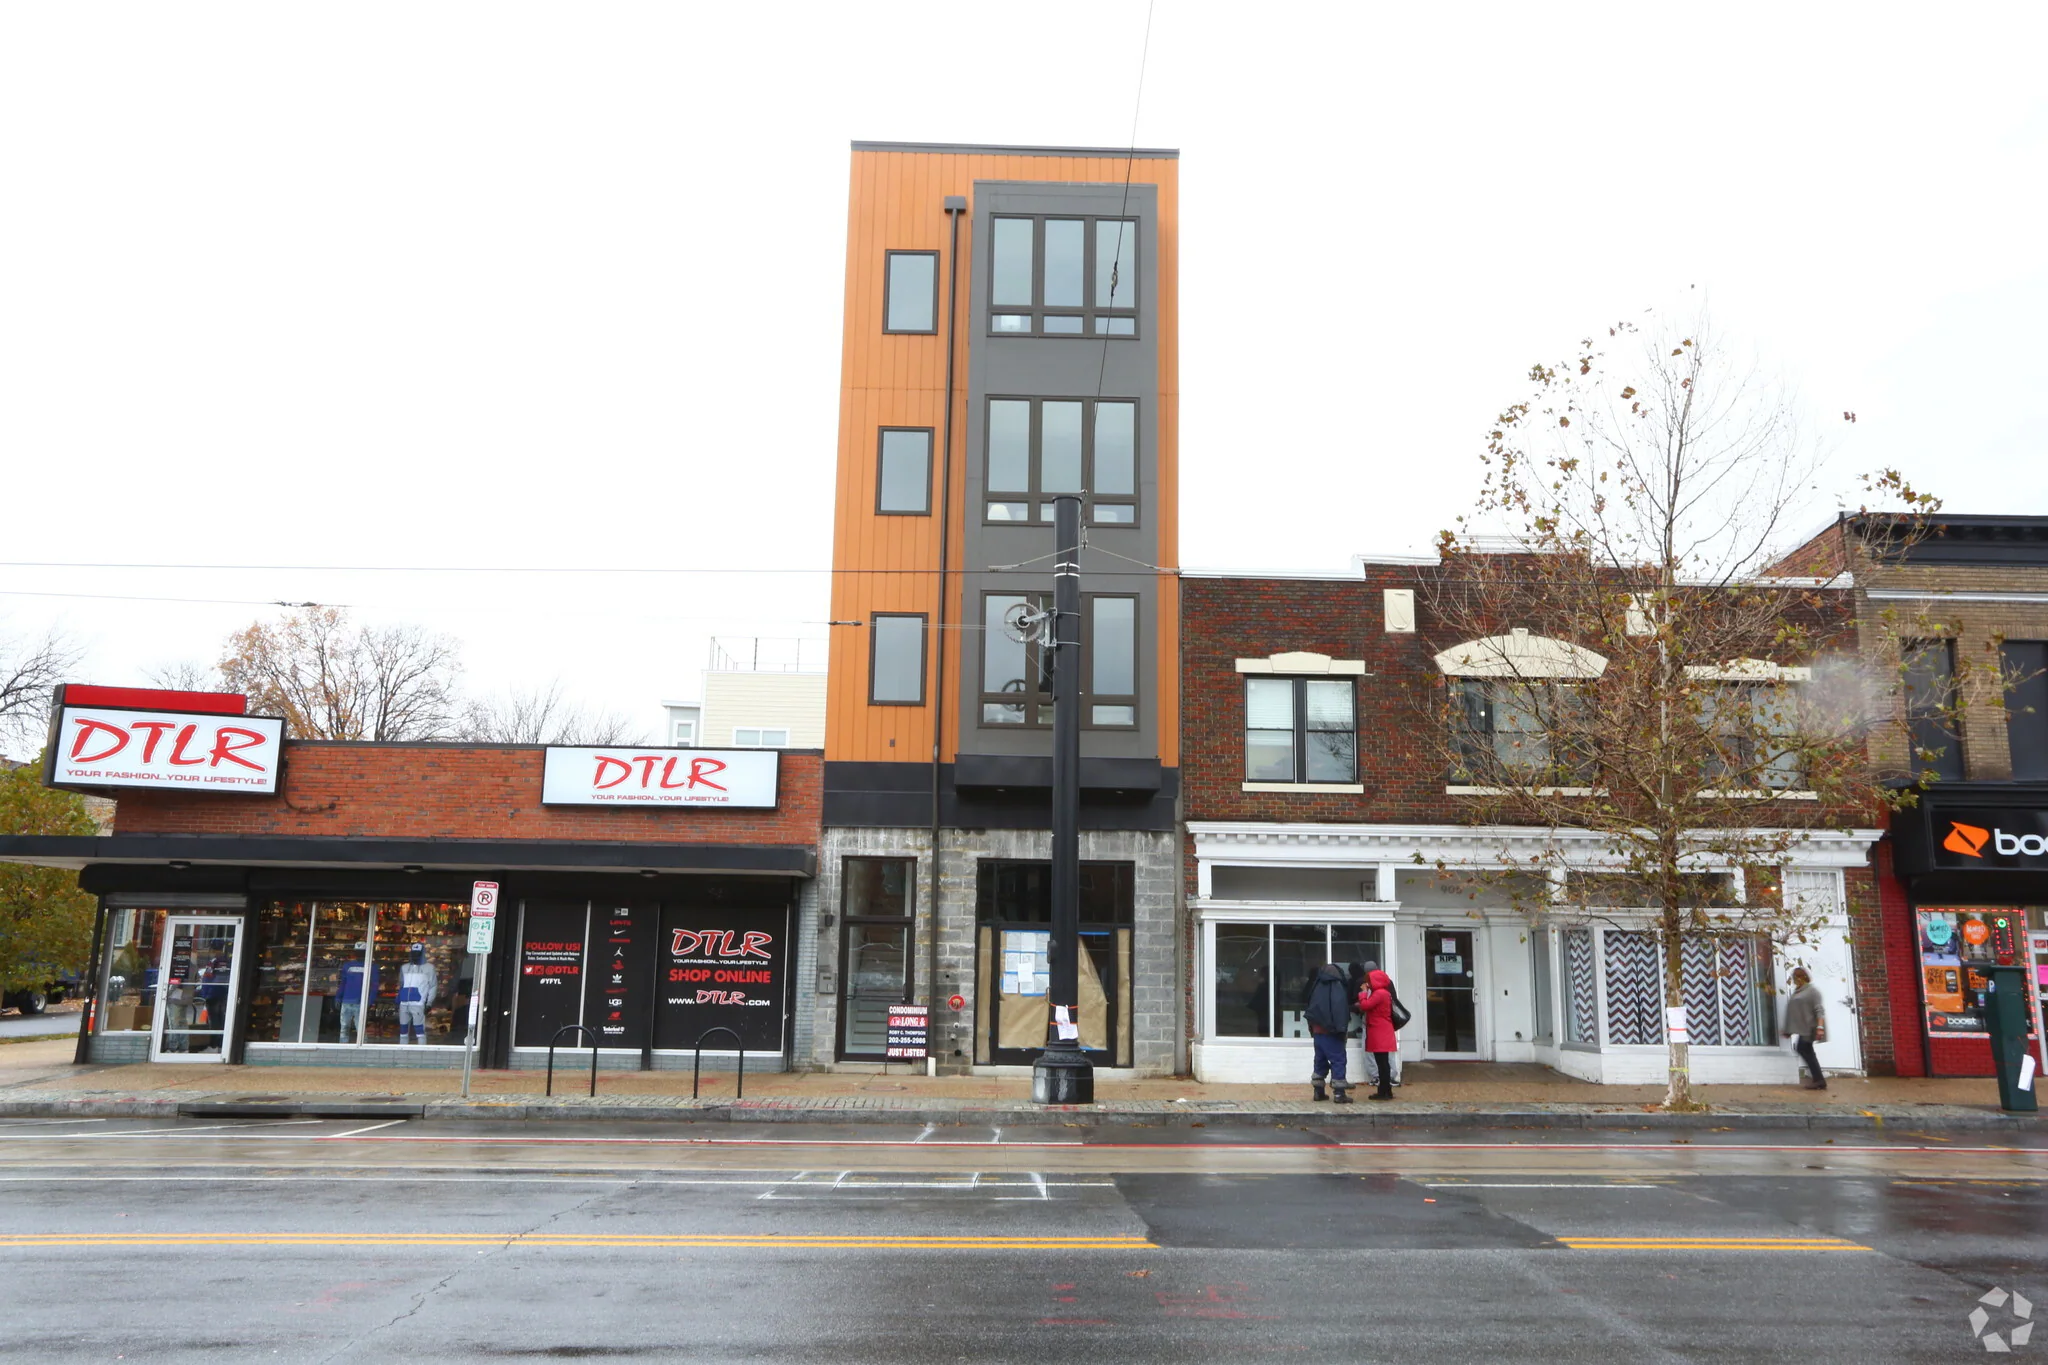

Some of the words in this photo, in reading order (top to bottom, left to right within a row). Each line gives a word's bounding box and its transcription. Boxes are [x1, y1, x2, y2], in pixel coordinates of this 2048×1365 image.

[70, 717, 266, 772] DTLR
[66, 769, 101, 778] YOUR
[204, 775, 267, 785] LIFESTYLE!
[593, 755, 728, 792] DTLR
[1994, 828, 2048, 856] bo
[525, 942, 563, 951] FOLLOW
[565, 942, 582, 951] US!
[671, 928, 772, 959] DTLR
[545, 965, 579, 975] @DTLR
[669, 969, 711, 982] SHOP
[714, 970, 772, 983] ONLINE
[889, 1005, 928, 1015] CONDOMINIUM
[901, 1016, 919, 1027] LONG
[920, 1017, 926, 1027] &
[1947, 1016, 1977, 1025] boost
[888, 1048, 903, 1057] JUST
[904, 1048, 926, 1057] LISTED!
